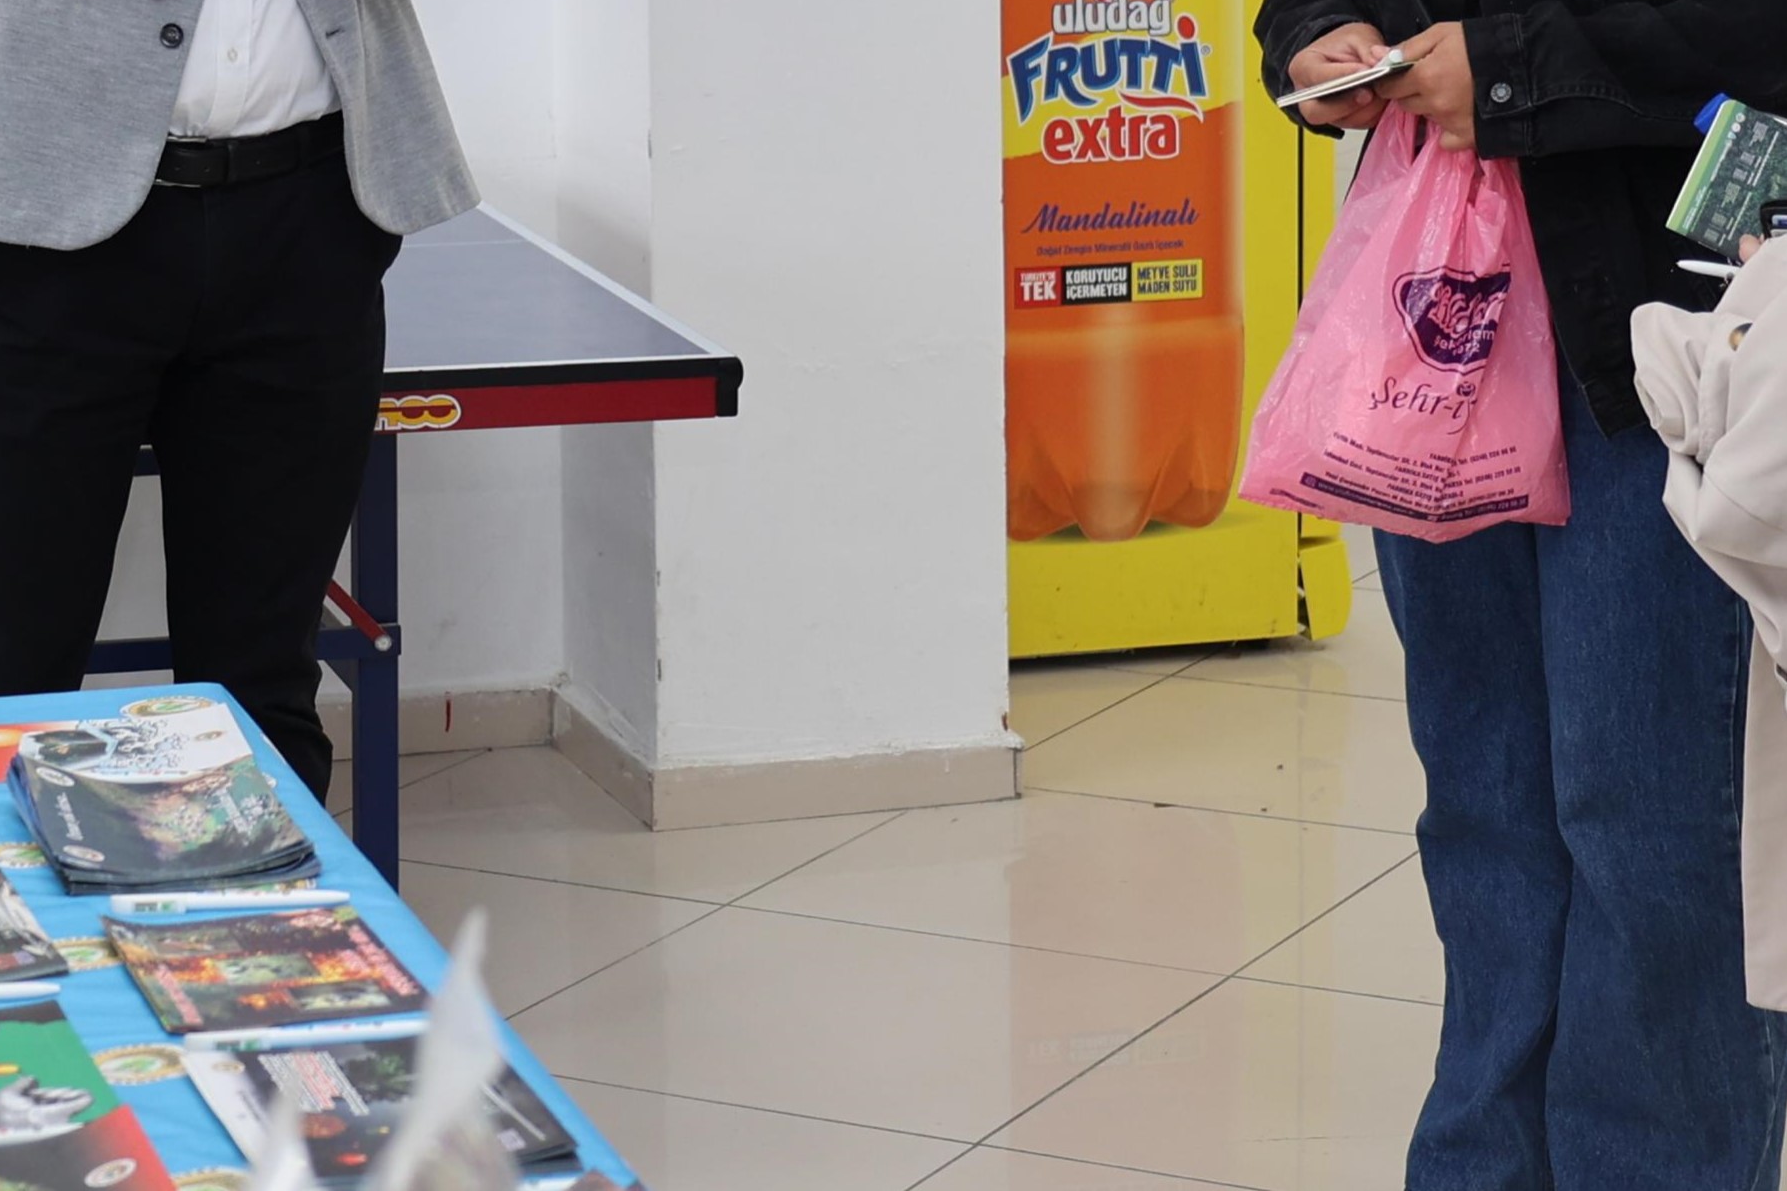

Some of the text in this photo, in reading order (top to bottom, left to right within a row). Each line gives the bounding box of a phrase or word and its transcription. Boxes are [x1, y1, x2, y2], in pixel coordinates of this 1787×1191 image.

[1043, 105, 1180, 163] extra
[1022, 199, 1200, 234] Mandalinalı
[1066, 267, 1128, 284] KORUYUCU
[1137, 265, 1197, 280] MEYVE SULU
[1020, 280, 1057, 302] TEK
[1066, 282, 1128, 300] İÇERMEYEN
[1137, 279, 1197, 294] MADEN SUYU
